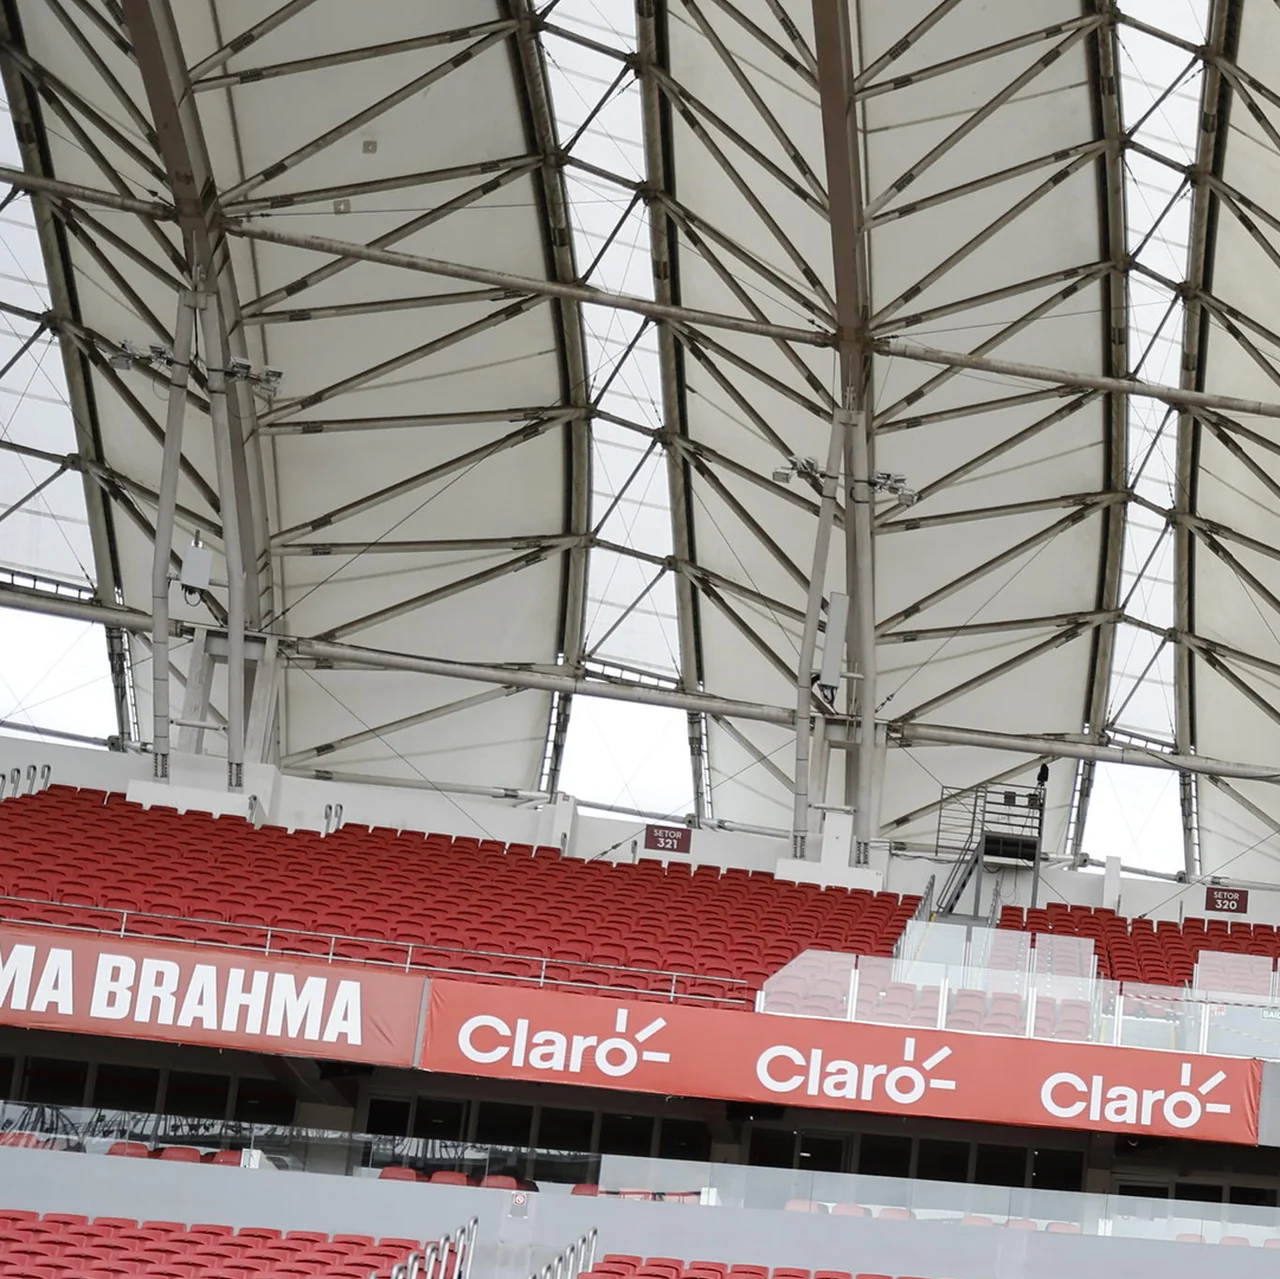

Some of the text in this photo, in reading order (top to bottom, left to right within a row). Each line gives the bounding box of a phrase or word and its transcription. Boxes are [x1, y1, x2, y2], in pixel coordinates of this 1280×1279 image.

[653, 828, 683, 840] SETOR
[656, 837, 678, 849] 321
[1213, 891, 1240, 900] SETOR
[1215, 899, 1237, 910] 320
[89, 953, 363, 1046] BRAHMA
[458, 1014, 638, 1077] Claro
[756, 1044, 926, 1104] Claro
[1040, 1071, 1202, 1128] Claro
